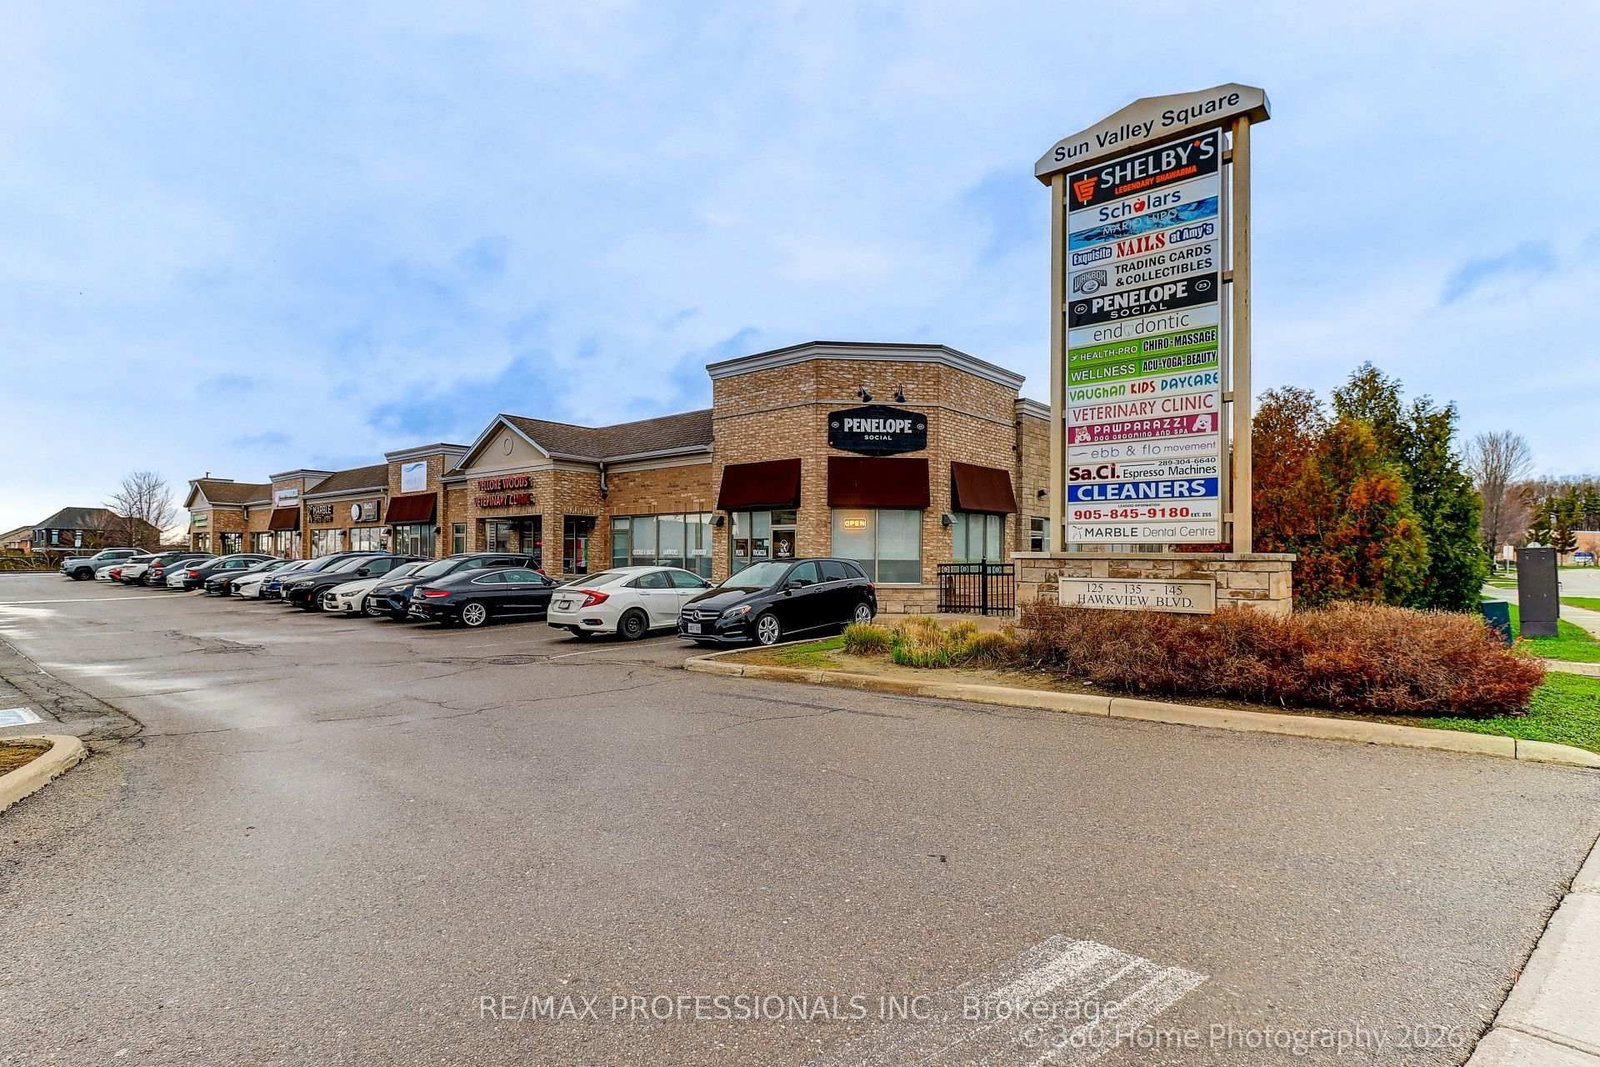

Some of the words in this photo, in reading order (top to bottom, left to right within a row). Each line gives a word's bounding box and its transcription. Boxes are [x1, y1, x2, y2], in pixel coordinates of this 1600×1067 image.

[1054, 141, 1089, 162] Sun
[1096, 119, 1154, 148] Valley
[1161, 92, 1240, 125] Square
[1100, 136, 1214, 189] SHELBY'S
[1114, 177, 1155, 195] LEGENDARY
[1155, 165, 1197, 184] SHAWARMA
[1072, 246, 1113, 266] Exquisite
[1116, 232, 1166, 258] NAILS
[1169, 232, 1182, 244] at
[1182, 223, 1214, 240] Amy's
[1115, 255, 1166, 275] TRADING
[1169, 244, 1212, 262] CARDS
[1092, 281, 1188, 314] PENELOPE
[1110, 302, 1168, 319] SOCIAL
[1071, 363, 1136, 382] WELLNESS
[1130, 381, 1156, 394] KIDS
[1161, 372, 1219, 391] DAYCARE
[1073, 400, 1157, 422] VETERINARY
[1161, 394, 1214, 413] CLINIC
[843, 418, 912, 433] PENELOPE
[1094, 417, 1187, 435] PAWPARAZZI
[1112, 431, 1153, 440] GROOMING
[1090, 447, 1120, 459] ebb
[1125, 445, 1136, 457] &
[1142, 444, 1161, 455] flo
[1163, 441, 1216, 452] movement
[1158, 457, 1216, 467] 289-304-6640
[1123, 469, 1165, 479] Espresso
[1168, 465, 1217, 476] Machines
[1077, 480, 1207, 501] CLEANERS
[1074, 507, 1190, 520] 905-845-9180
[844, 519, 865, 527] OPEN
[1084, 527, 1138, 538] MARBLE
[1142, 526, 1177, 537] Dental
[1179, 526, 1216, 537] Centre
[1086, 583, 1104, 593] 125
[1124, 584, 1142, 594] 135
[1164, 585, 1183, 595] 145
[1077, 594, 1149, 606] HAWKVIEW
[1156, 597, 1194, 608] BLVD.
